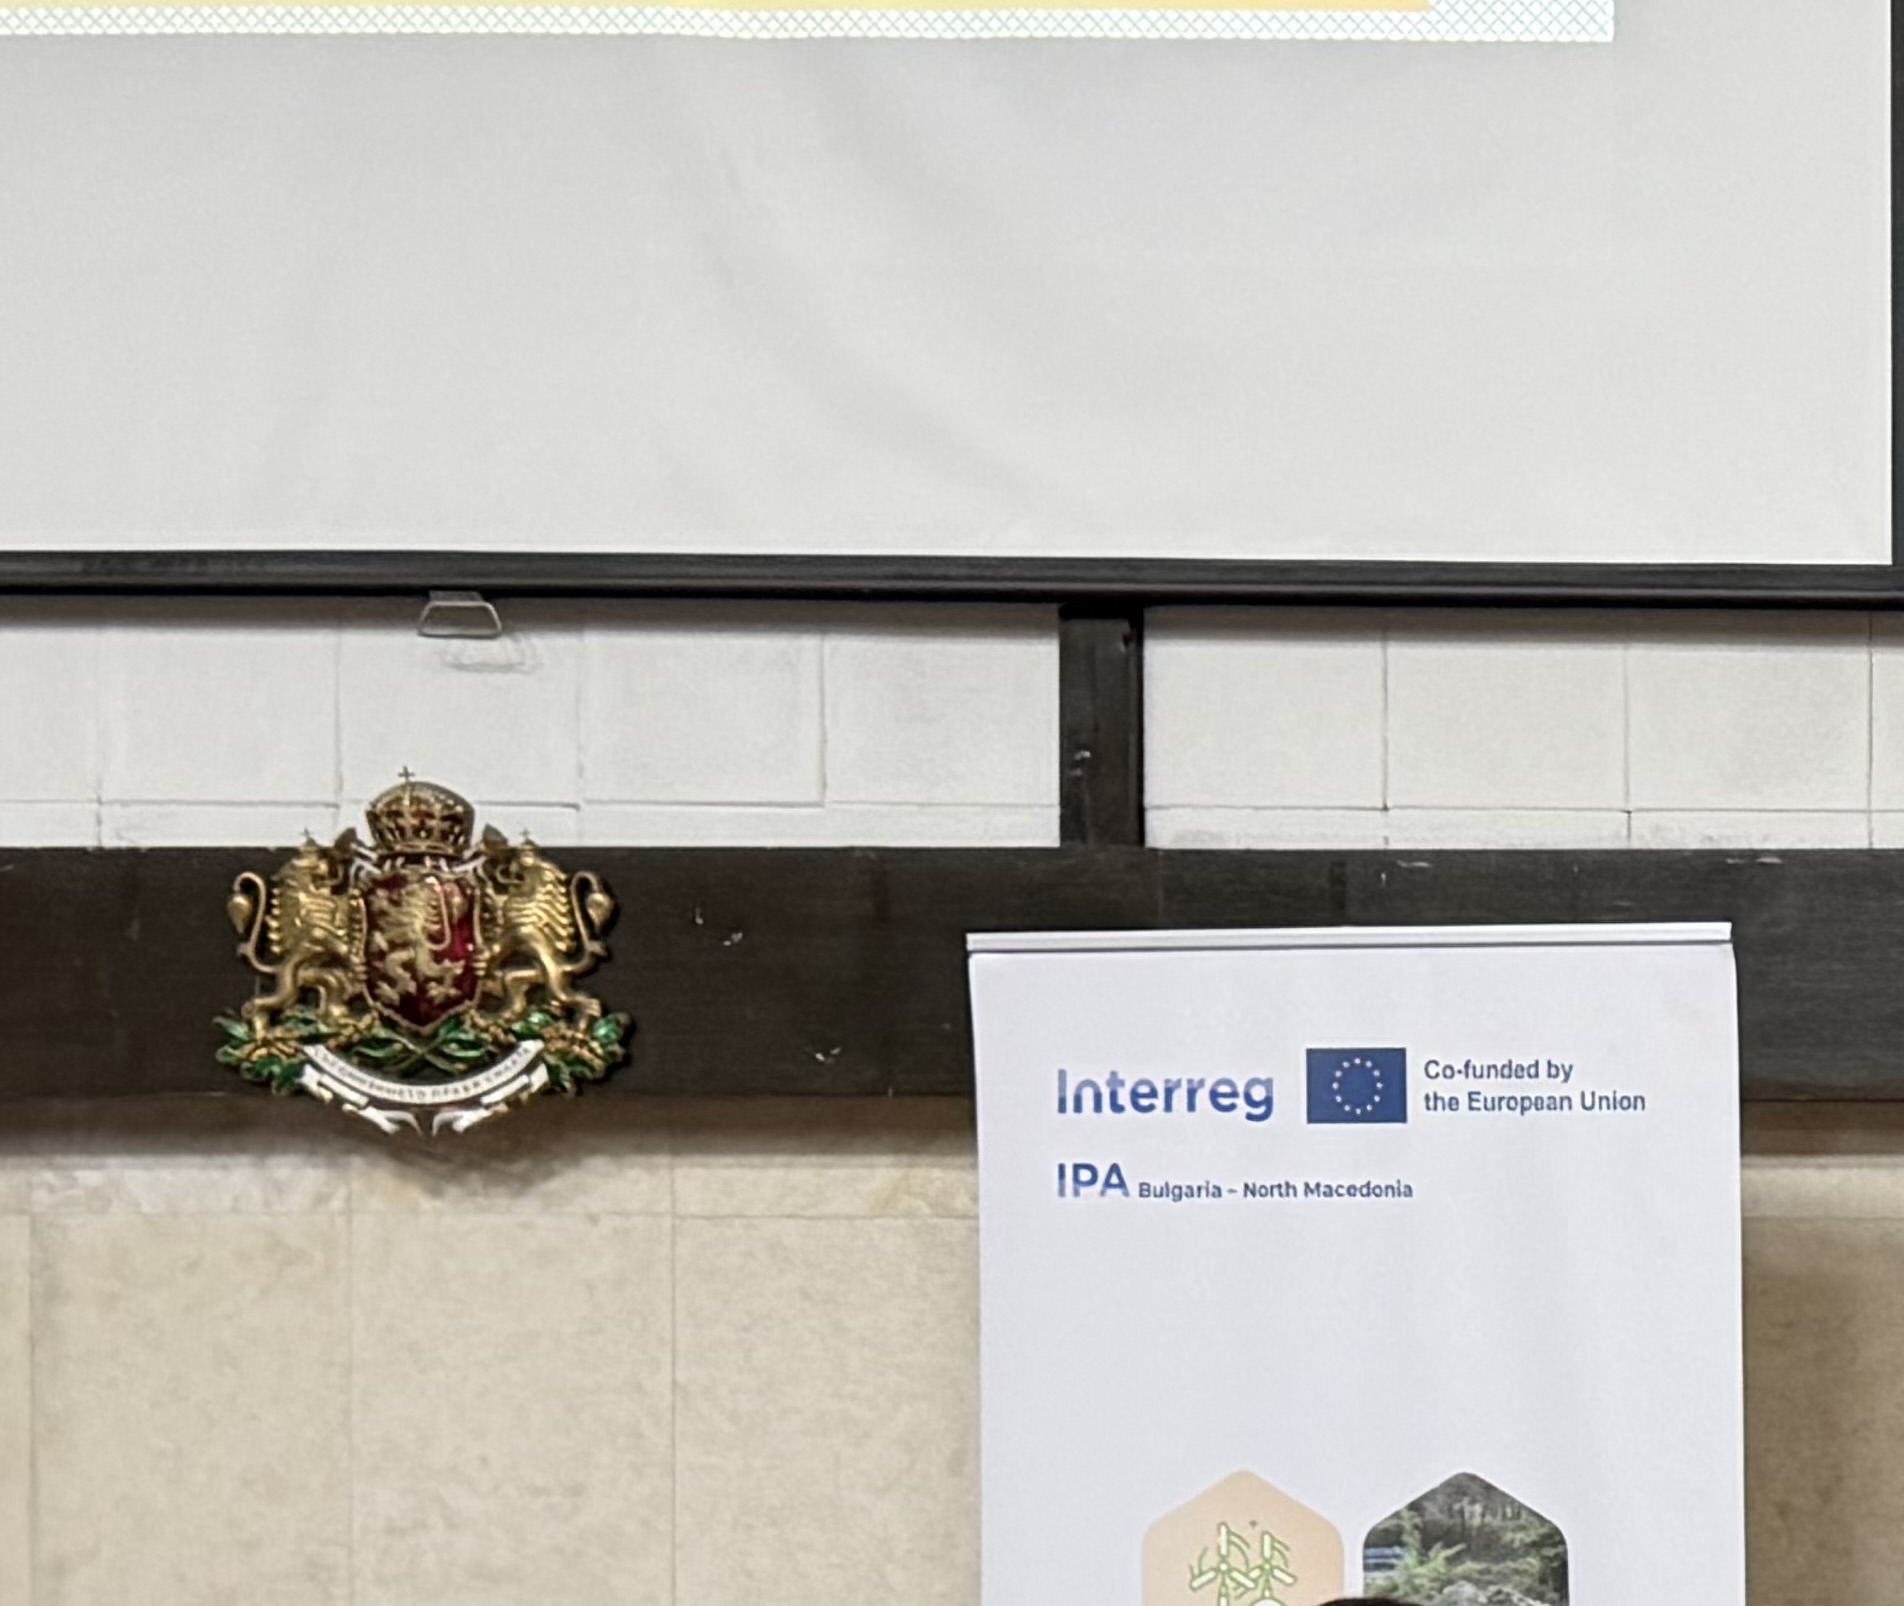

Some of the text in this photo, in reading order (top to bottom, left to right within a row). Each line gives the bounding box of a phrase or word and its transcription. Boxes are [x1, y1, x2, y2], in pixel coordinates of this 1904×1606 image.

[1424, 1059, 1574, 1084] Co-funded by
[1057, 1068, 1275, 1123] Interreg
[1424, 1090, 1646, 1116] the European Union
[1057, 1162, 1130, 1199] IPA
[1138, 1180, 1222, 1203] Bulgaria
[1243, 1180, 1297, 1199] North
[1304, 1179, 1414, 1199] Macedonia
